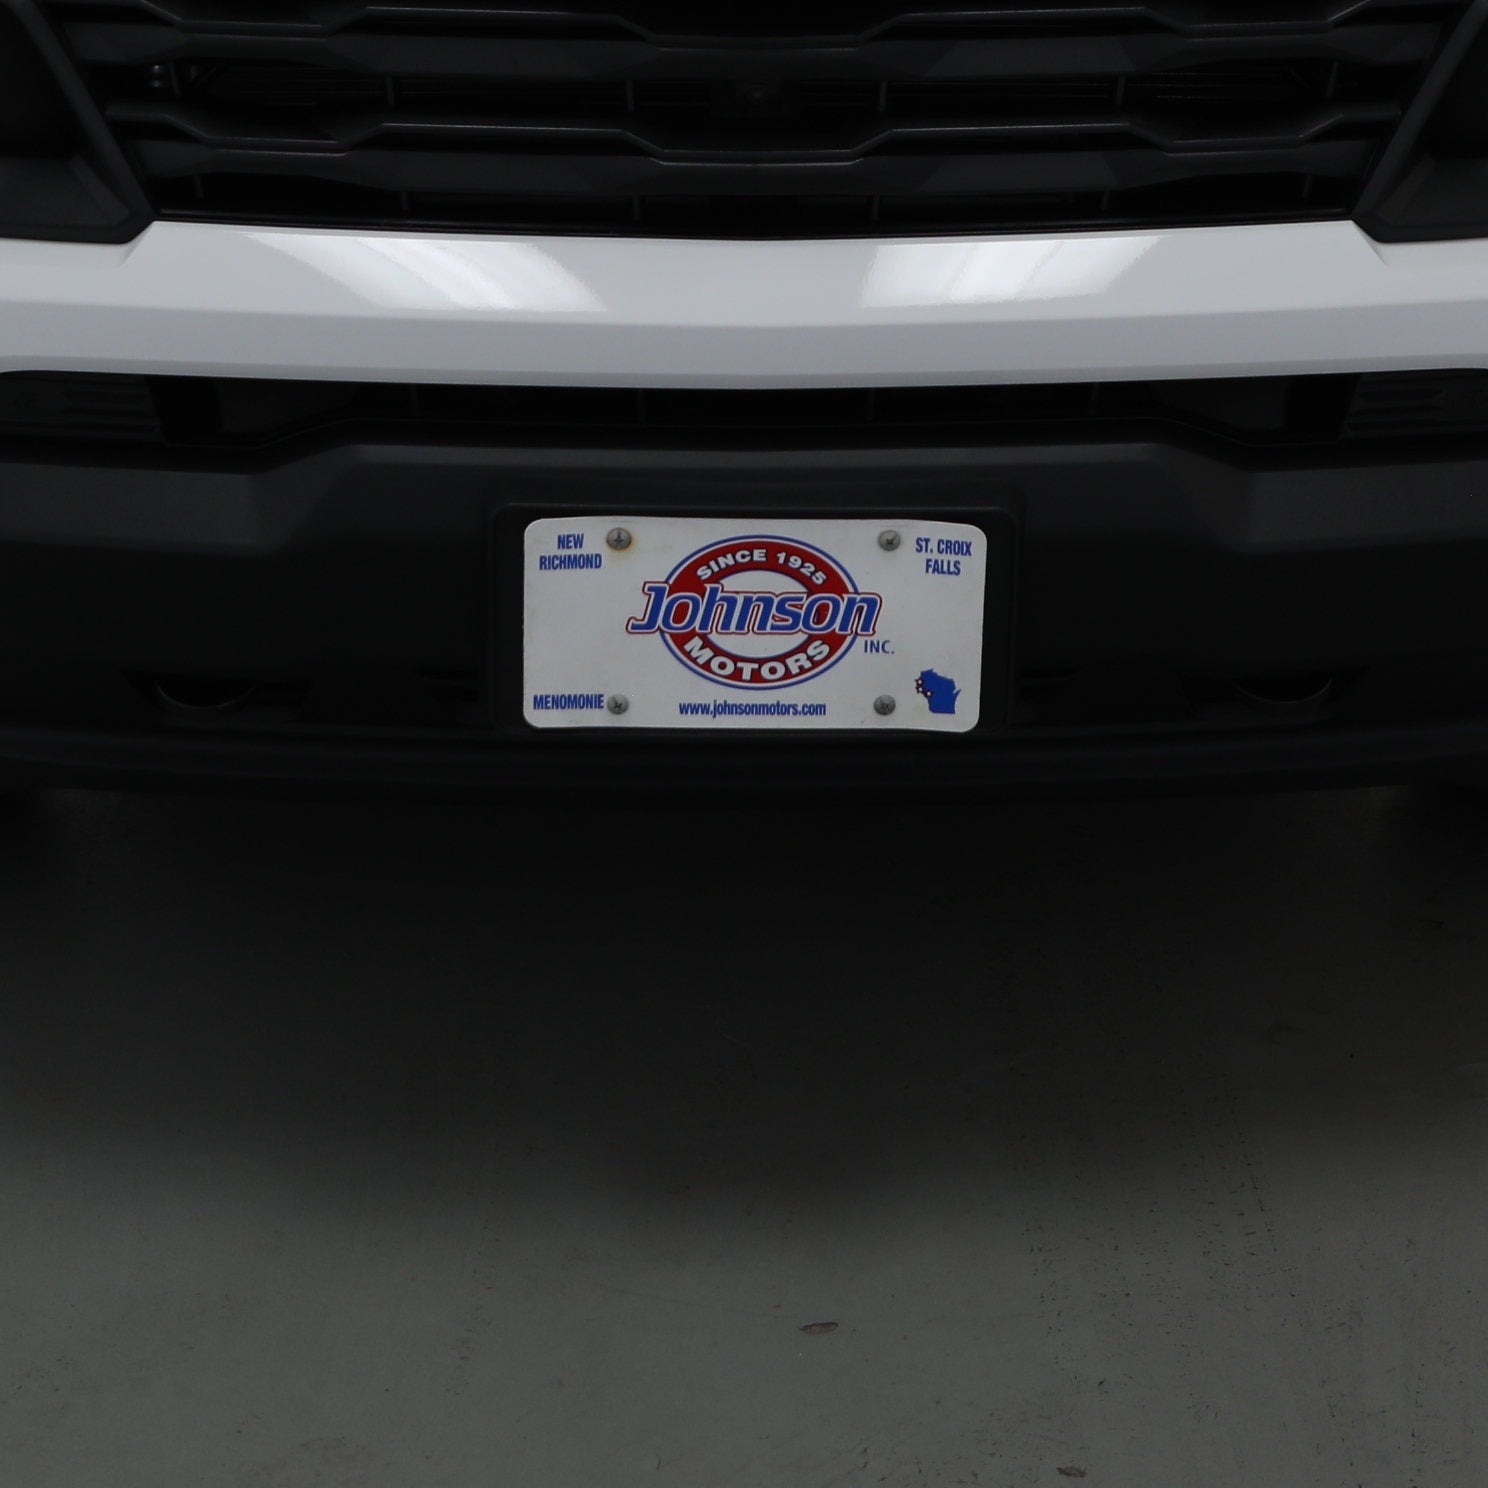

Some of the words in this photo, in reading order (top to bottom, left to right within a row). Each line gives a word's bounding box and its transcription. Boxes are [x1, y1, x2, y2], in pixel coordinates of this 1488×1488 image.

[557, 534, 584, 549] NEW
[915, 538, 933, 553] ST.
[937, 539, 972, 556] CROIX
[539, 554, 602, 570] RICHMOND
[696, 549, 767, 580] SINCE
[776, 552, 827, 585] 1925
[925, 559, 961, 576] FALLS
[626, 581, 882, 636] Johnson
[864, 640, 895, 655] INC.
[683, 636, 831, 681] MOTORS
[533, 694, 604, 710] MENOMONIE
[679, 700, 826, 719] www.johnsonmotors.com
